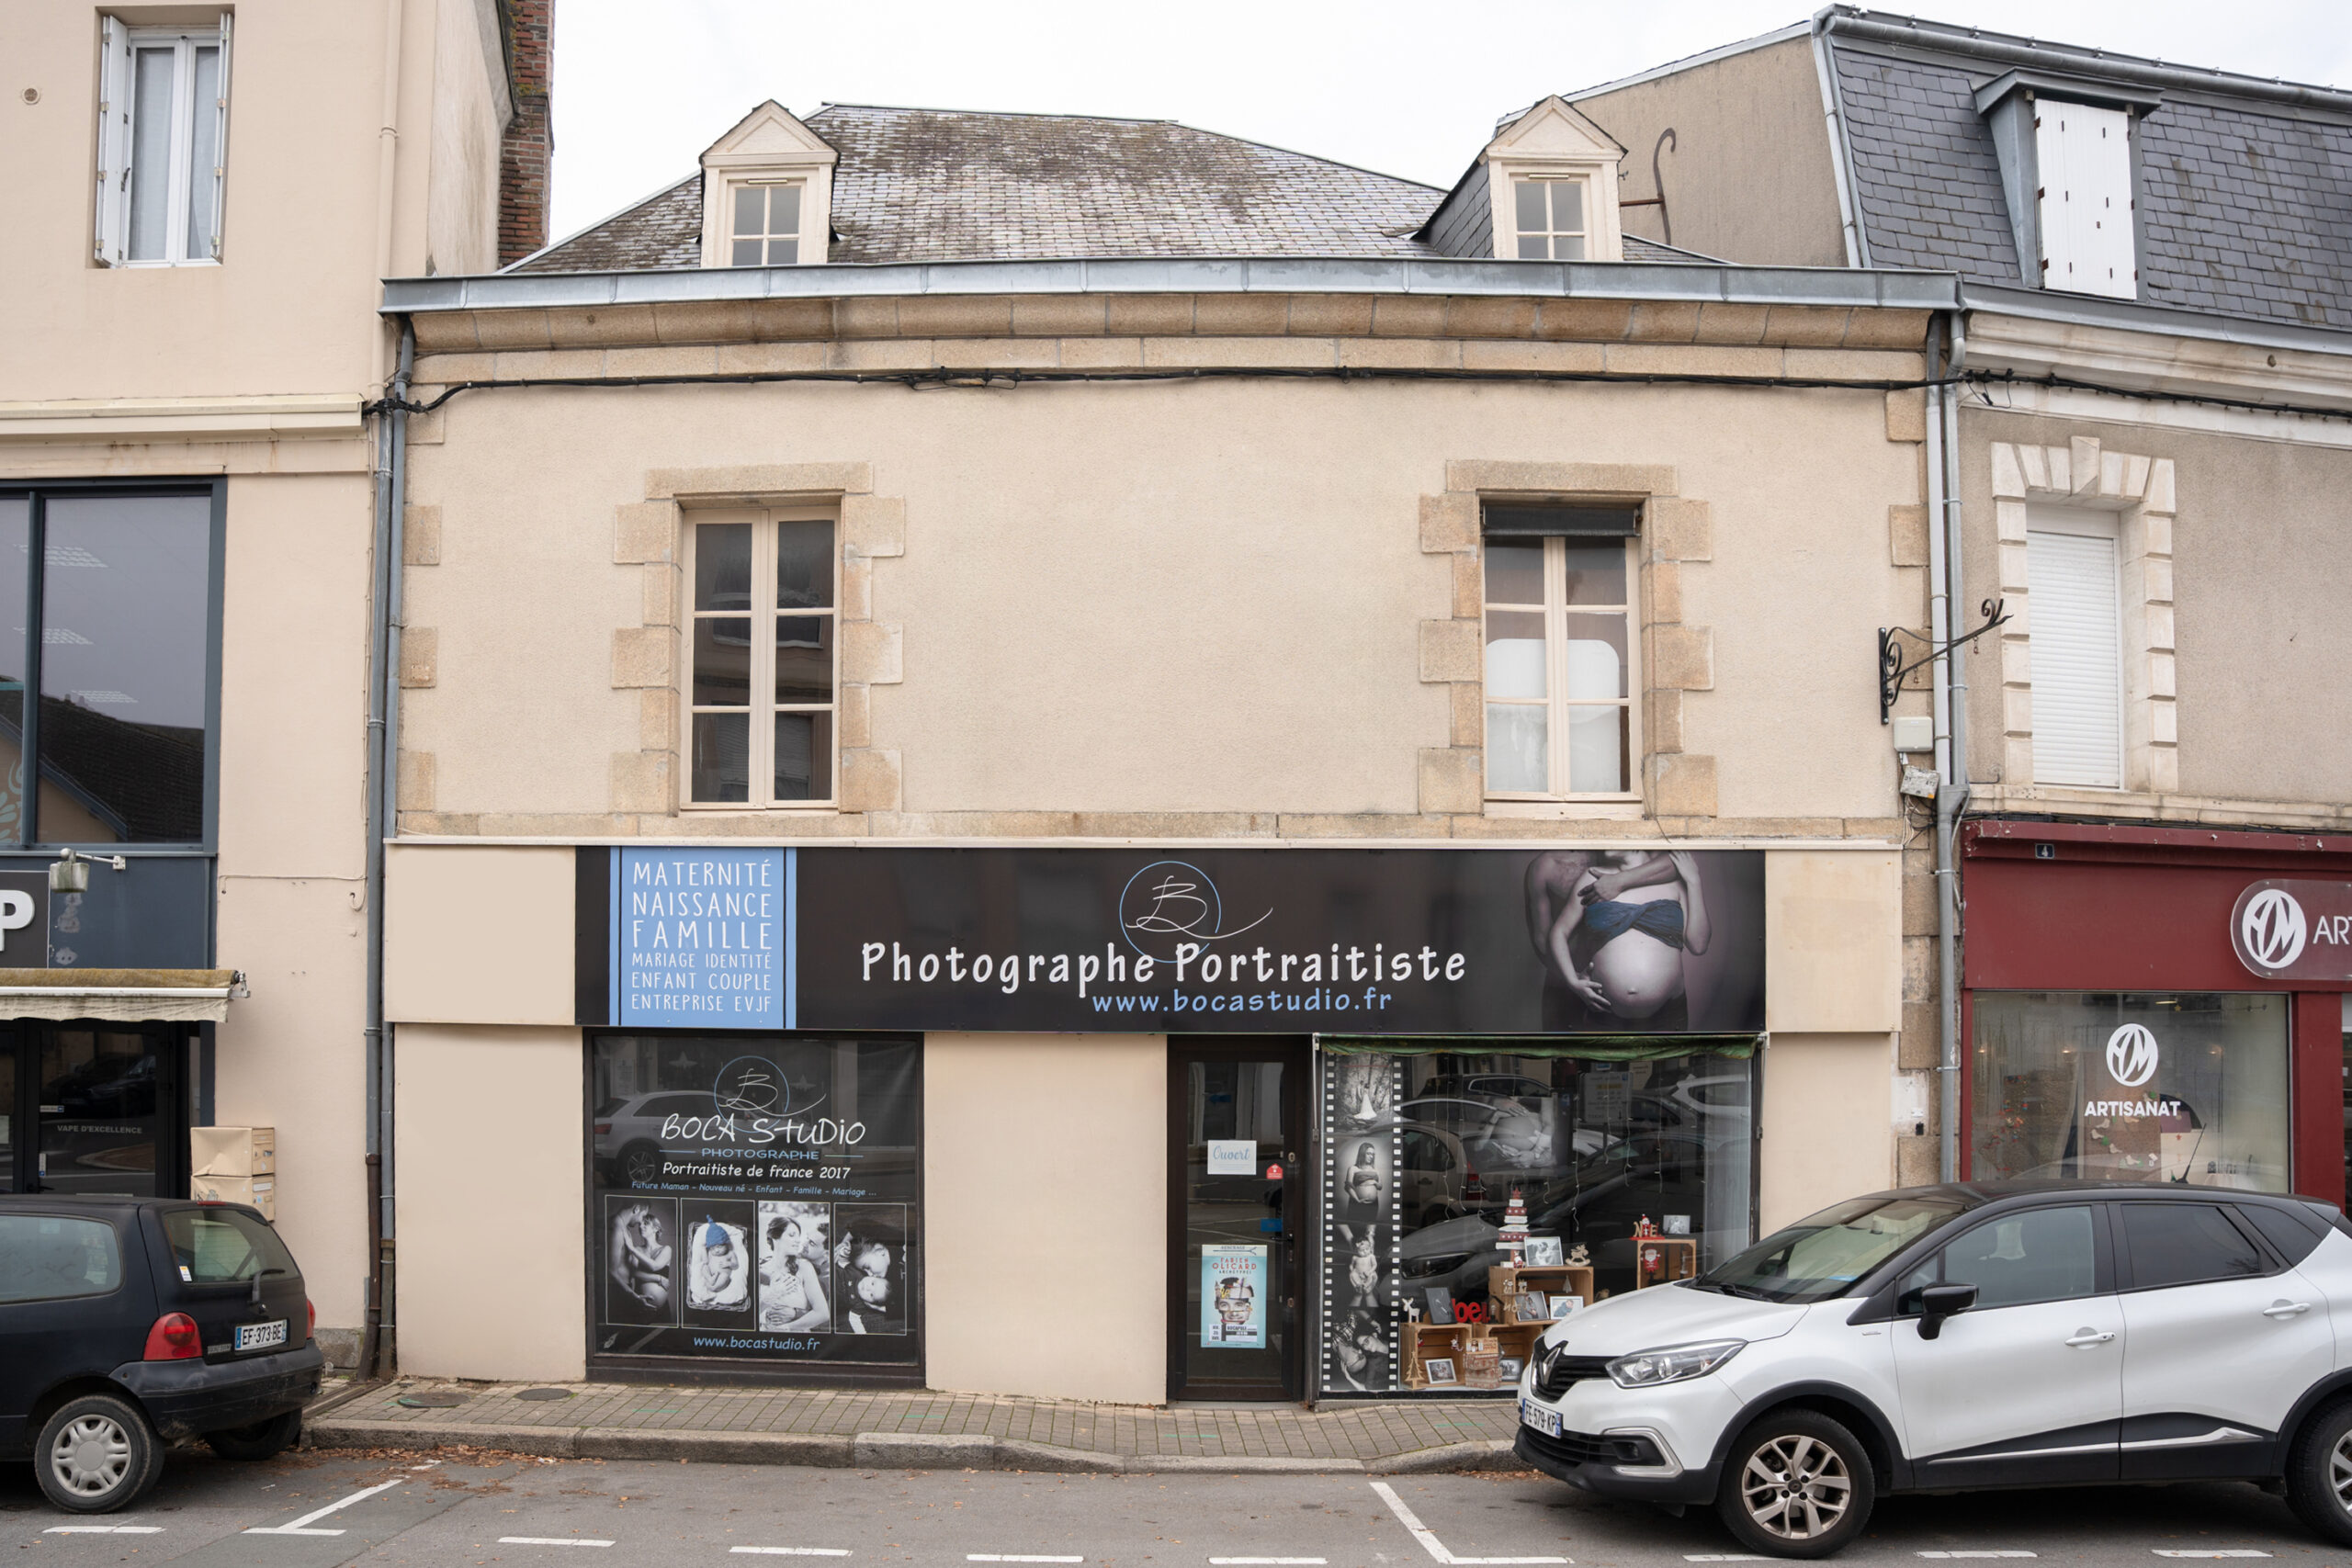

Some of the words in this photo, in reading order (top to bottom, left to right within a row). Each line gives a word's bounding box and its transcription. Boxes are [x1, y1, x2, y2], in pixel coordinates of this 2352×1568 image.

[633, 859, 773, 887] MATERNITÉ
[632, 891, 773, 919] NAISSANCE
[632, 919, 773, 950] FAMILLE
[631, 953, 696, 968] MARIAGE
[705, 952, 773, 970] IDENTITÉ
[862, 942, 1155, 998] Photographe
[1175, 942, 1465, 983] Portraitiste
[631, 971, 698, 990] ENFANT
[707, 973, 773, 991] COUPLE
[631, 994, 725, 1012] ENTREPRISE
[734, 996, 773, 1013] EVJF
[1091, 986, 1393, 1012] www.bocastudio.fr
[2084, 1100, 2182, 1117] ARTISANAT
[81, 1125, 142, 1134] D'EXCELLENCE
[661, 1112, 736, 1143] BOCA
[701, 1147, 820, 1161] PHOTOGRAPHE
[1213, 1145, 1250, 1160] Ouvert
[662, 1162, 742, 1178] Portraitiste
[747, 1164, 763, 1178] de
[769, 1164, 814, 1179] france
[819, 1167, 852, 1180] 2017
[631, 1181, 659, 1190] Future
[661, 1182, 689, 1190] Maman
[698, 1183, 733, 1192] Nouveau
[754, 1185, 783, 1194] Enfant
[793, 1186, 822, 1195] Famille
[831, 1188, 866, 1198] Mariage
[243, 1324, 282, 1346] EF-373-BE
[693, 1336, 821, 1352] www.bocastudio.fr
